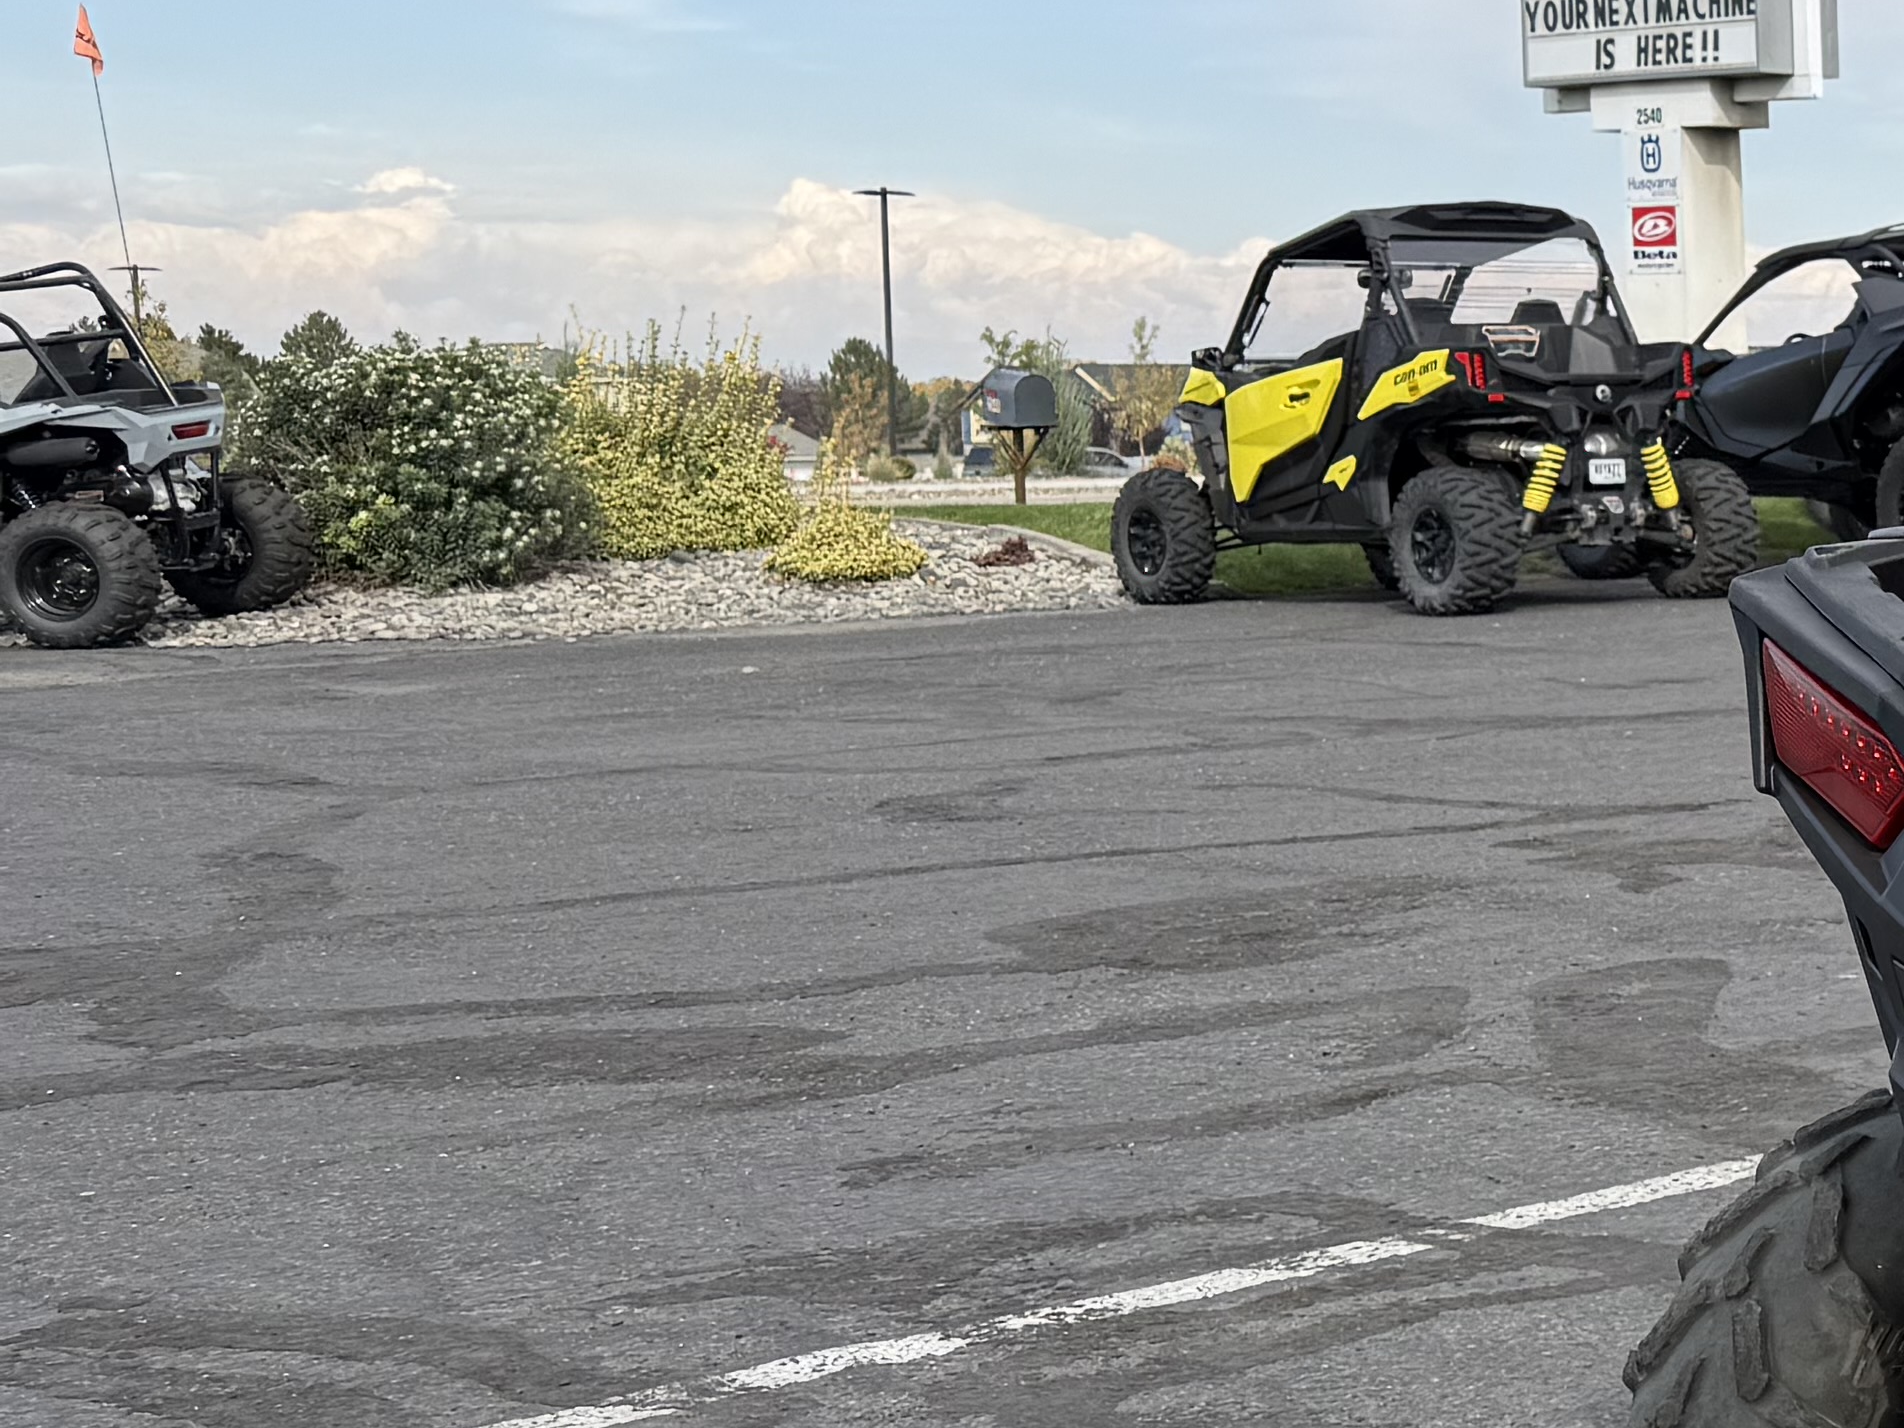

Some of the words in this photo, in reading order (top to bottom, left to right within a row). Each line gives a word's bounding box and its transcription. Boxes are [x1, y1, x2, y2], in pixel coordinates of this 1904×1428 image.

[1595, 38, 1616, 71] IS
[1636, 28, 1720, 67] HERE!!
[1636, 107, 1662, 125] 2540
[1633, 250, 1678, 260] Beta
